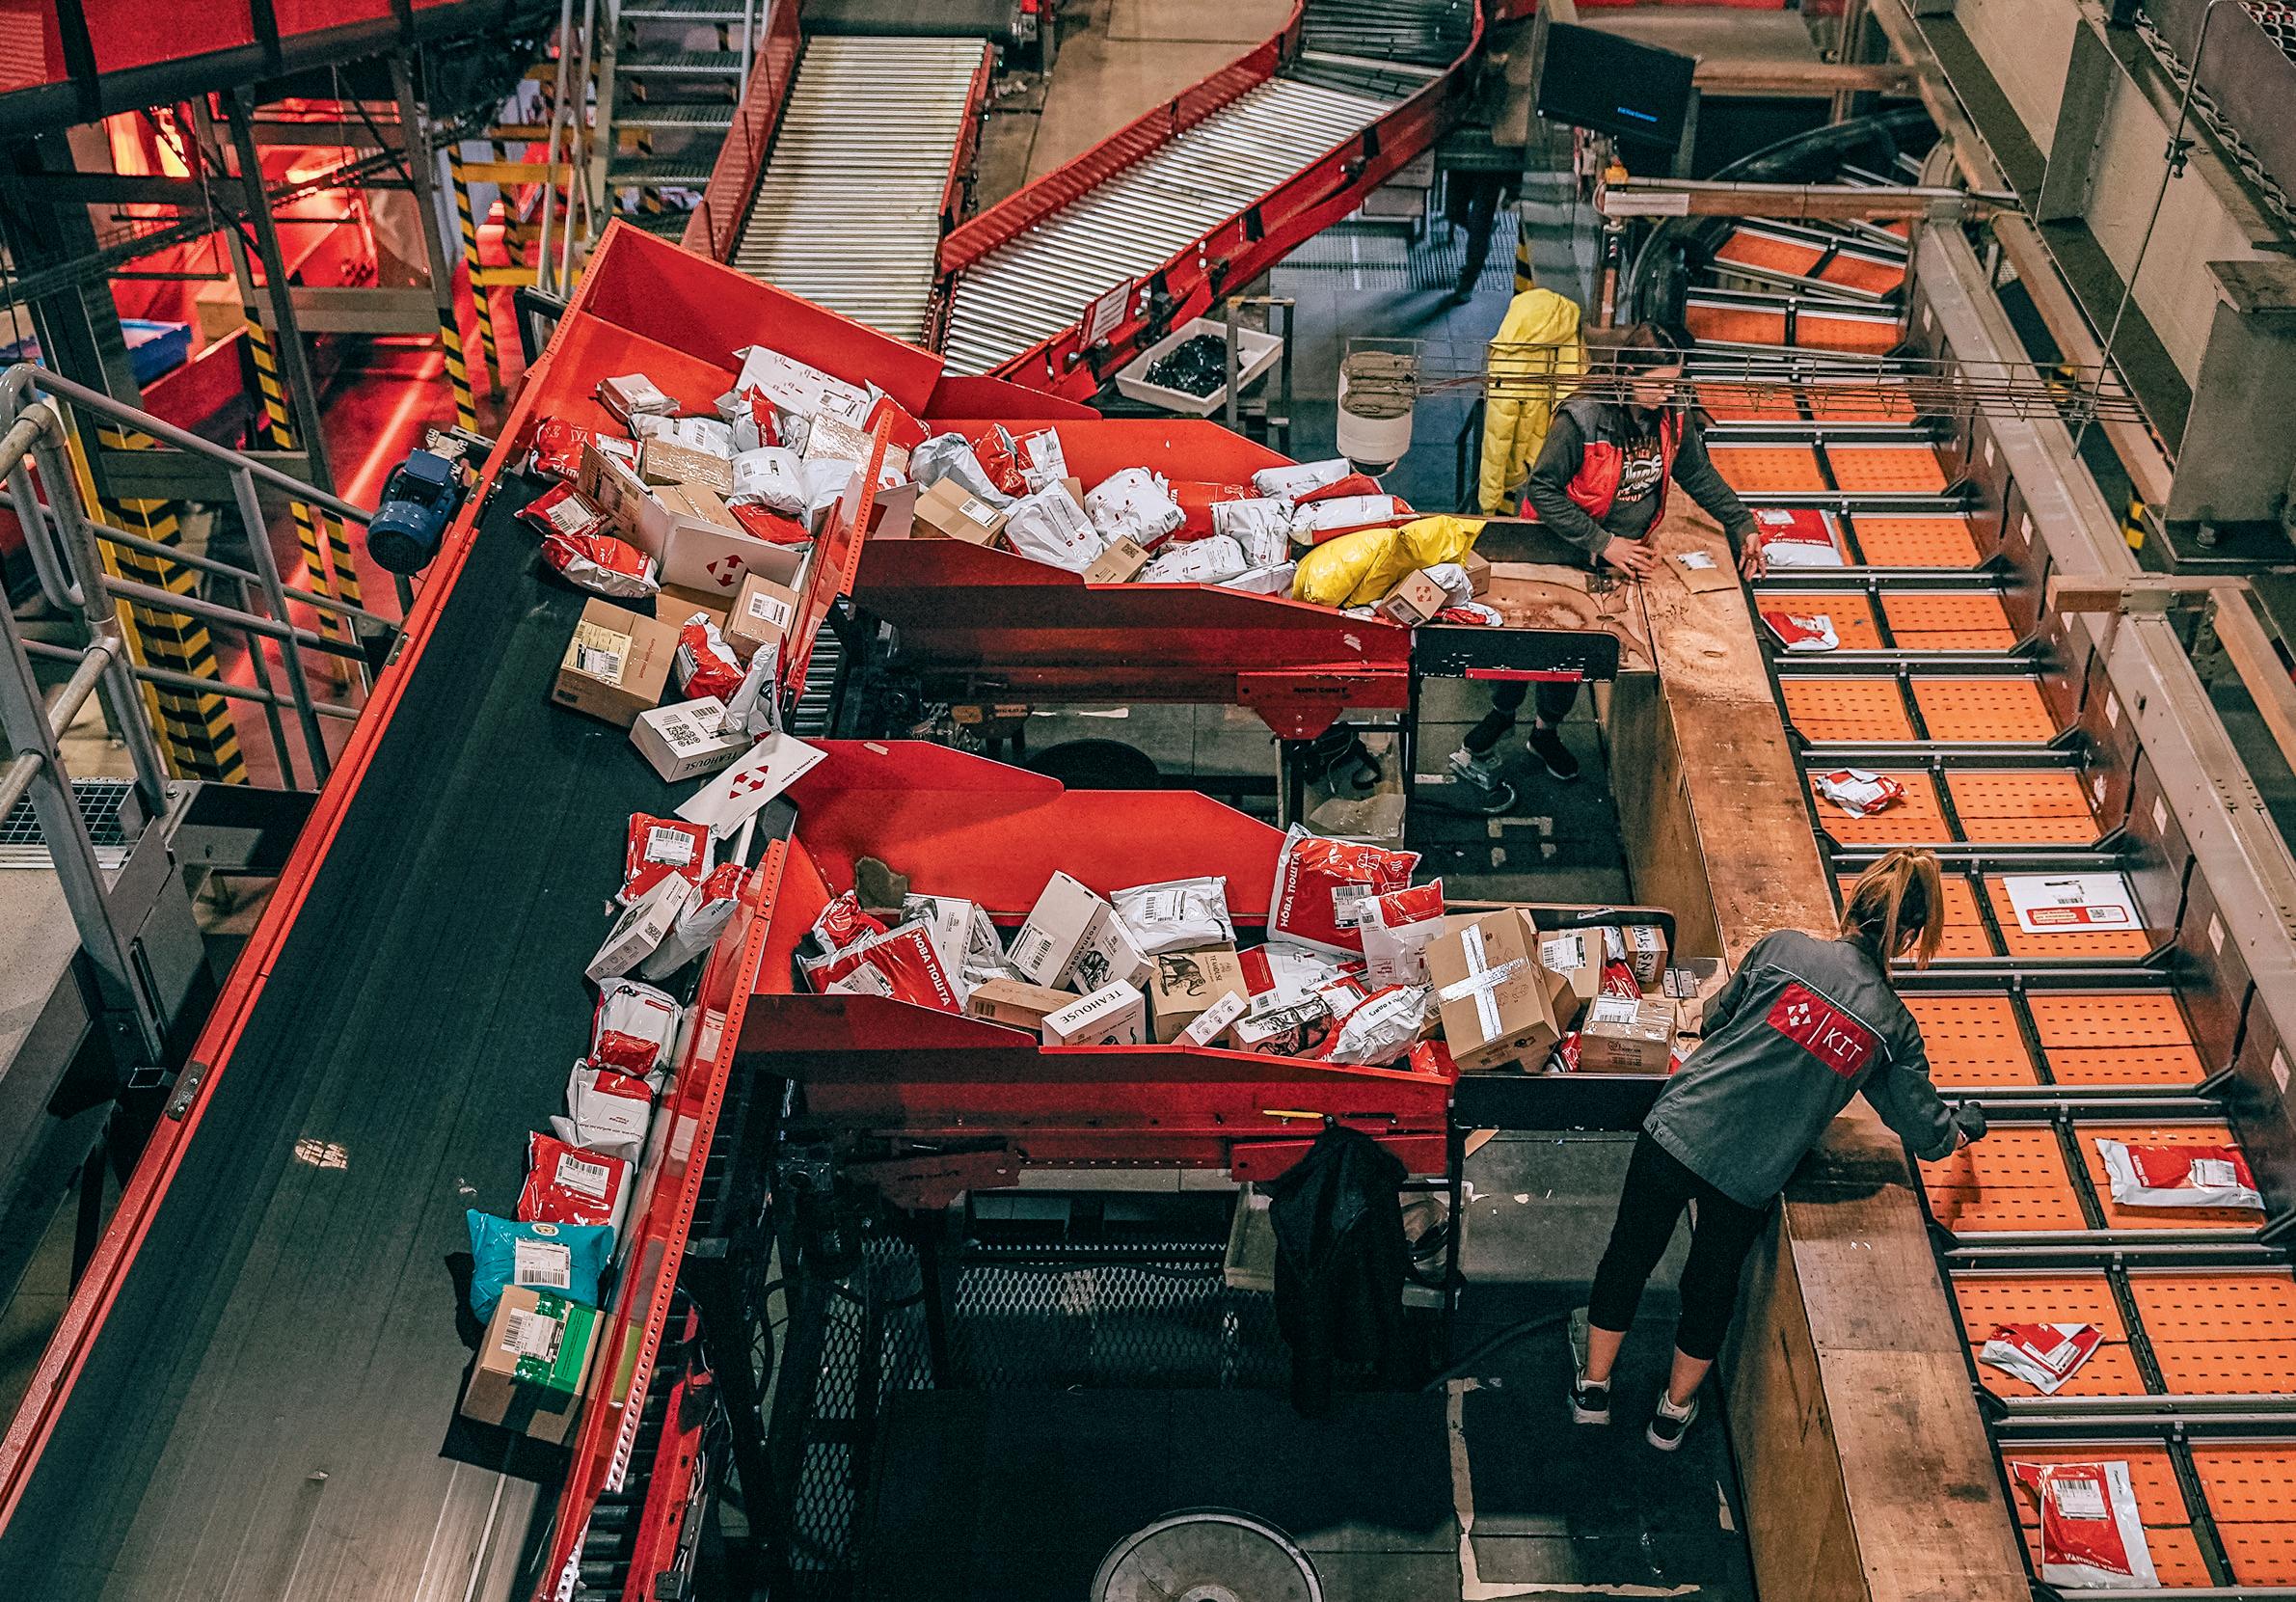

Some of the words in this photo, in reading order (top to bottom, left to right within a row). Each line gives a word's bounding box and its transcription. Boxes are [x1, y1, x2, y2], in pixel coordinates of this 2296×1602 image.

[685, 750, 739, 770] TEAHOUSE
[1286, 851, 1302, 893] ПОШТА
[1281, 895, 1294, 927] НОВА
[1065, 925, 1097, 976] РОЗПАКОВКА
[912, 934, 932, 964] НОВА
[927, 963, 952, 1007] ПОШТА
[1209, 955, 1223, 981] TEAHOUSE
[1060, 990, 1123, 1024] TEAHOUSE
